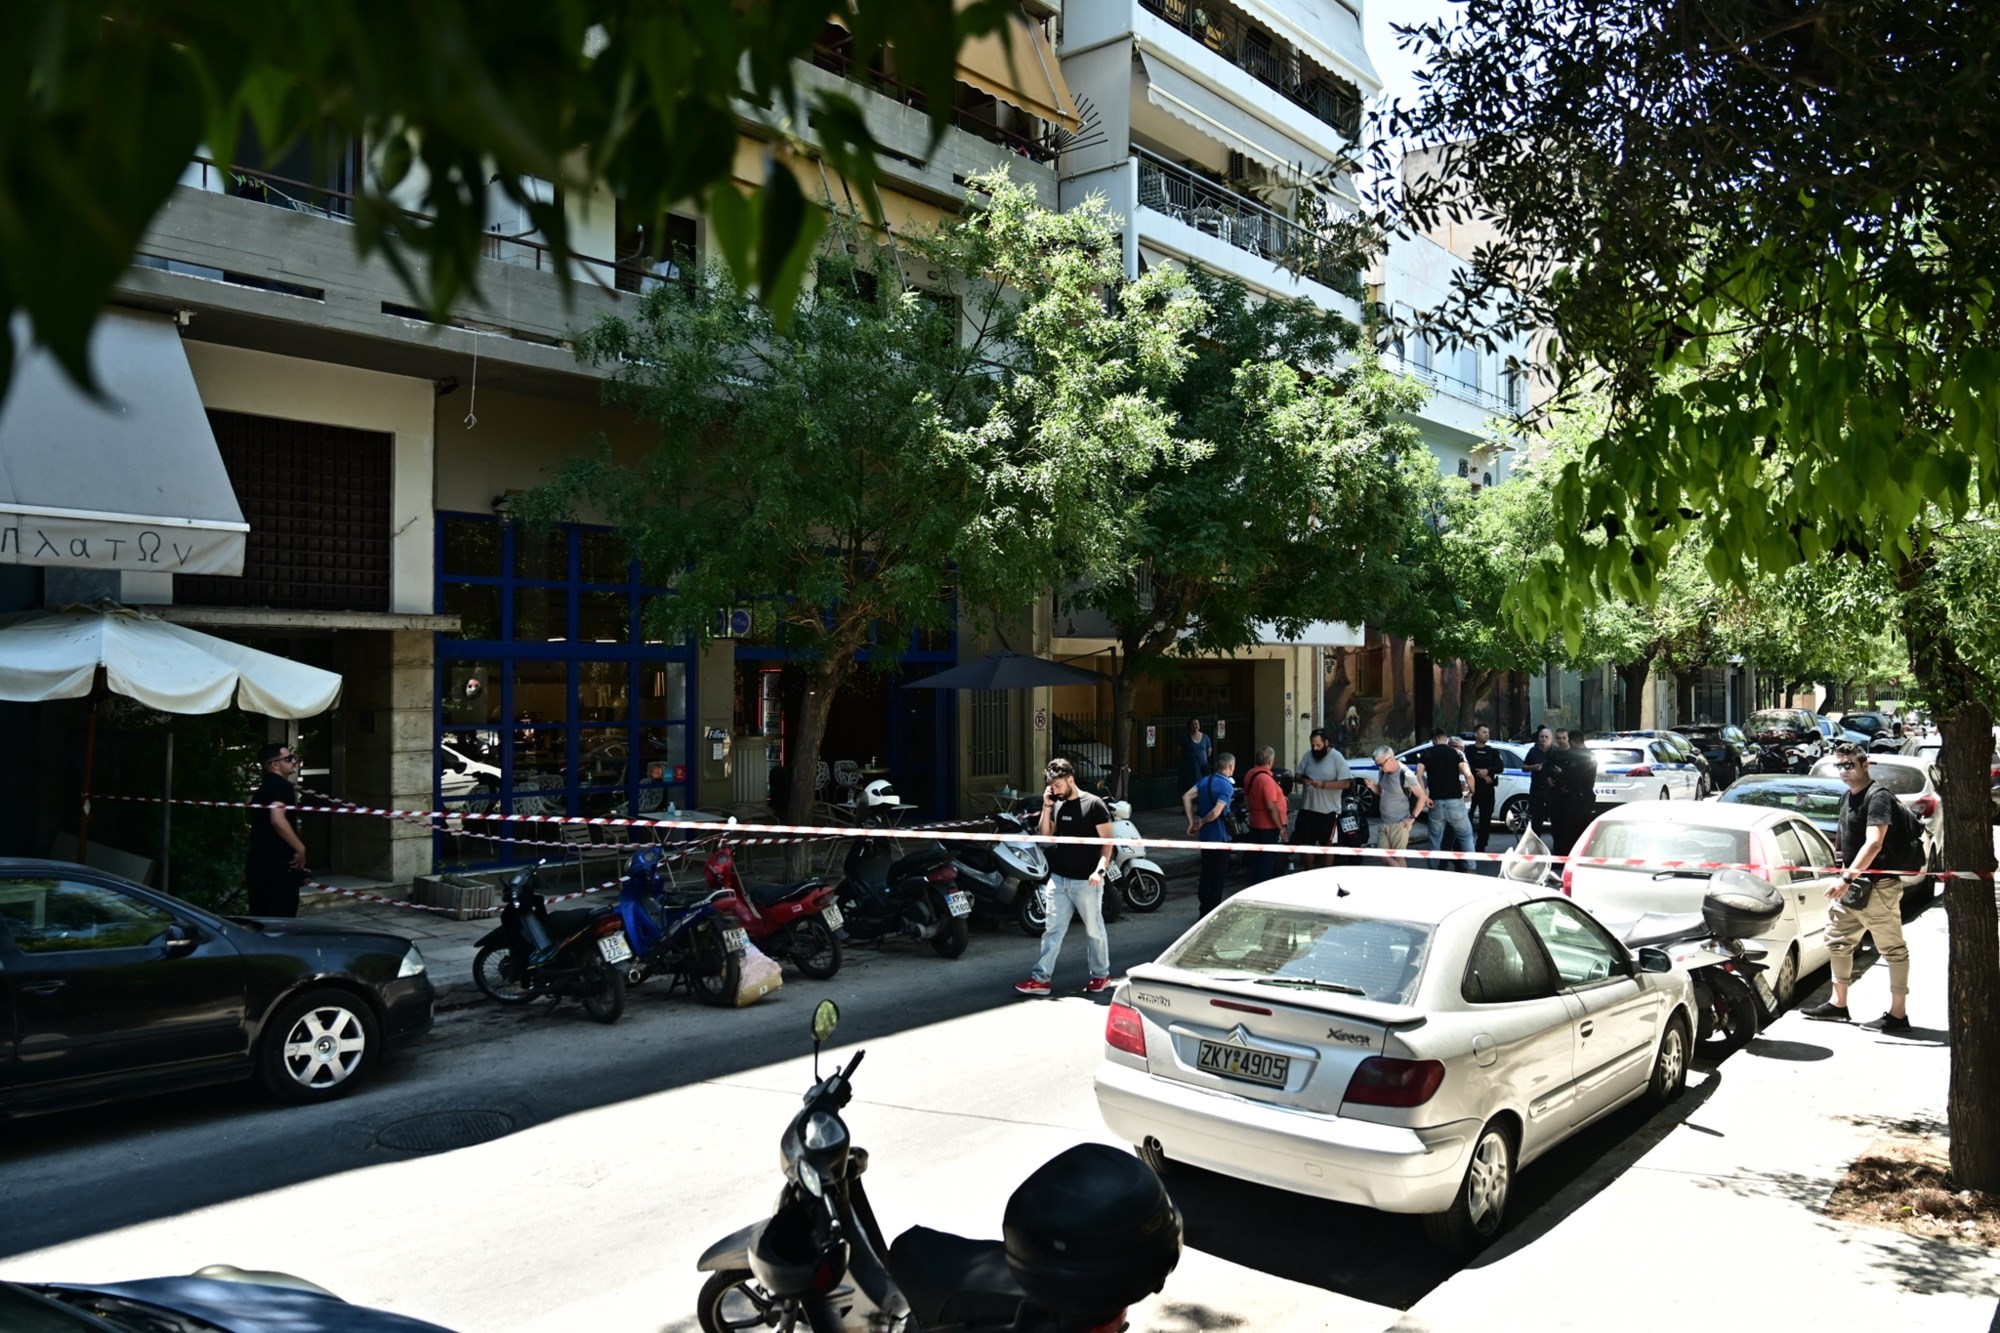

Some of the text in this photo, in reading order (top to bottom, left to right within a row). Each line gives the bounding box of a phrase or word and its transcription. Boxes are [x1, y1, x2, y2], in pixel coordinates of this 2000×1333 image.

[605, 946, 623, 959] 270
[1200, 1043, 1286, 1080] ZKY 4905
